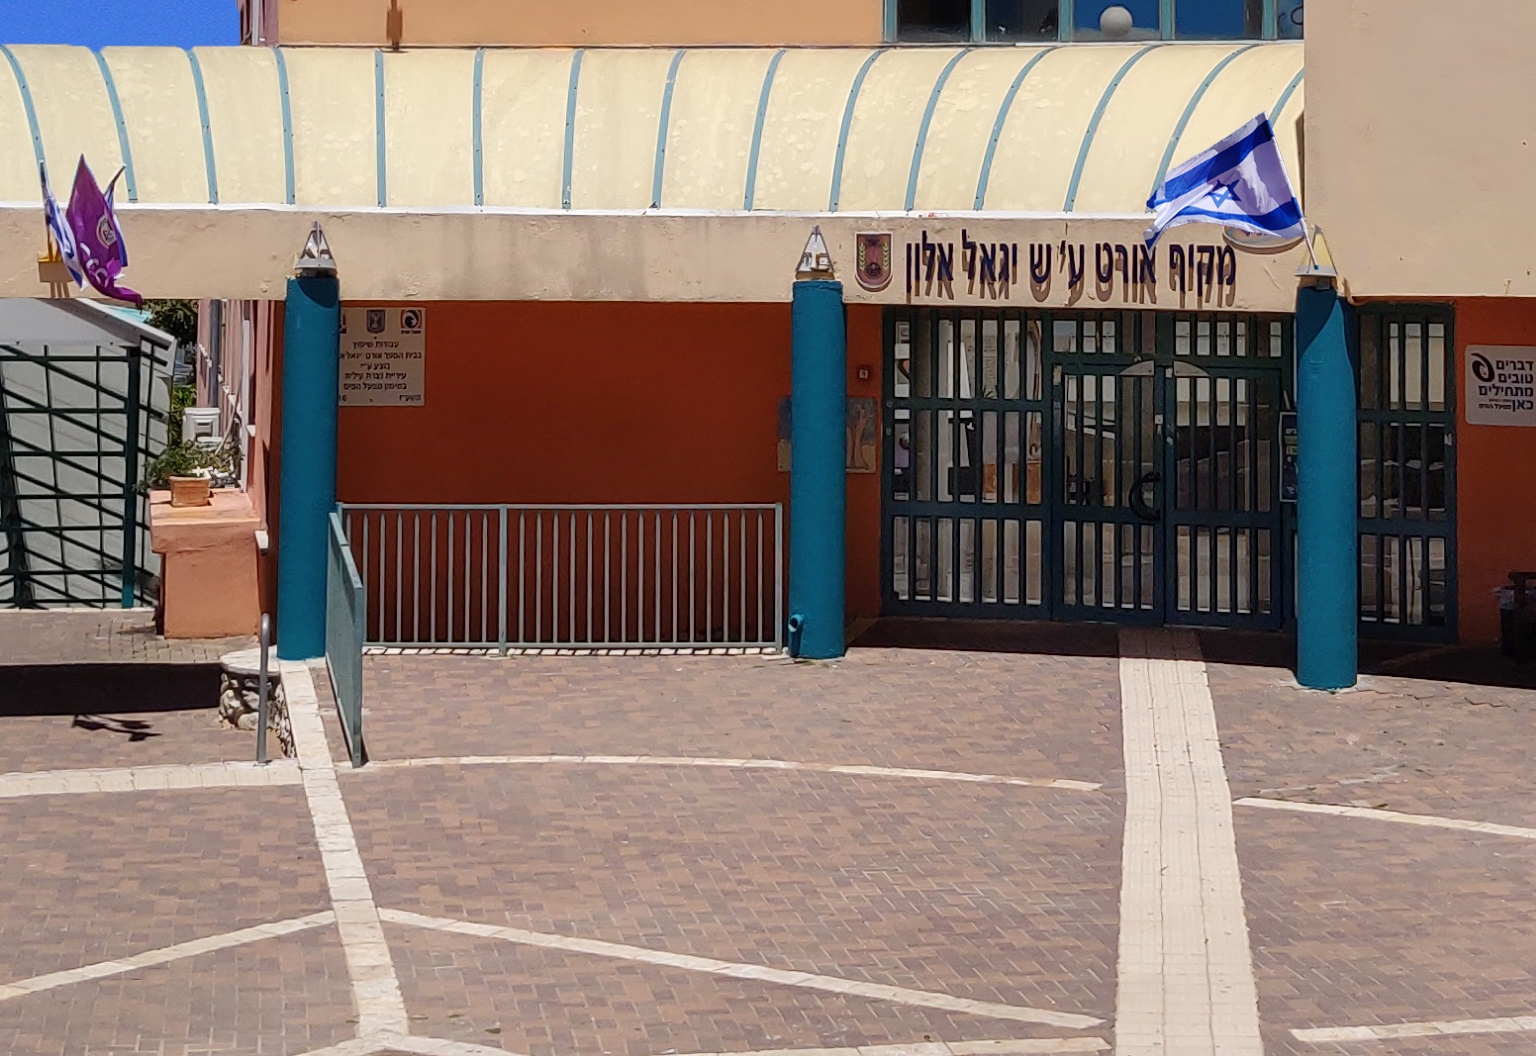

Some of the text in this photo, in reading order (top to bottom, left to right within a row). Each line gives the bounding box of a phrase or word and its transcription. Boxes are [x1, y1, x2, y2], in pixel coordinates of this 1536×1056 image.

[906, 230, 954, 294] אלון
[962, 229, 1017, 285] יגאל
[1095, 242, 1156, 284] אורט
[1169, 243, 1236, 297] מקיף
[1496, 360, 1534, 372] דברים
[1498, 373, 1534, 384] טובים
[1478, 384, 1534, 397] מתחילים
[1512, 399, 1534, 413] כאן
